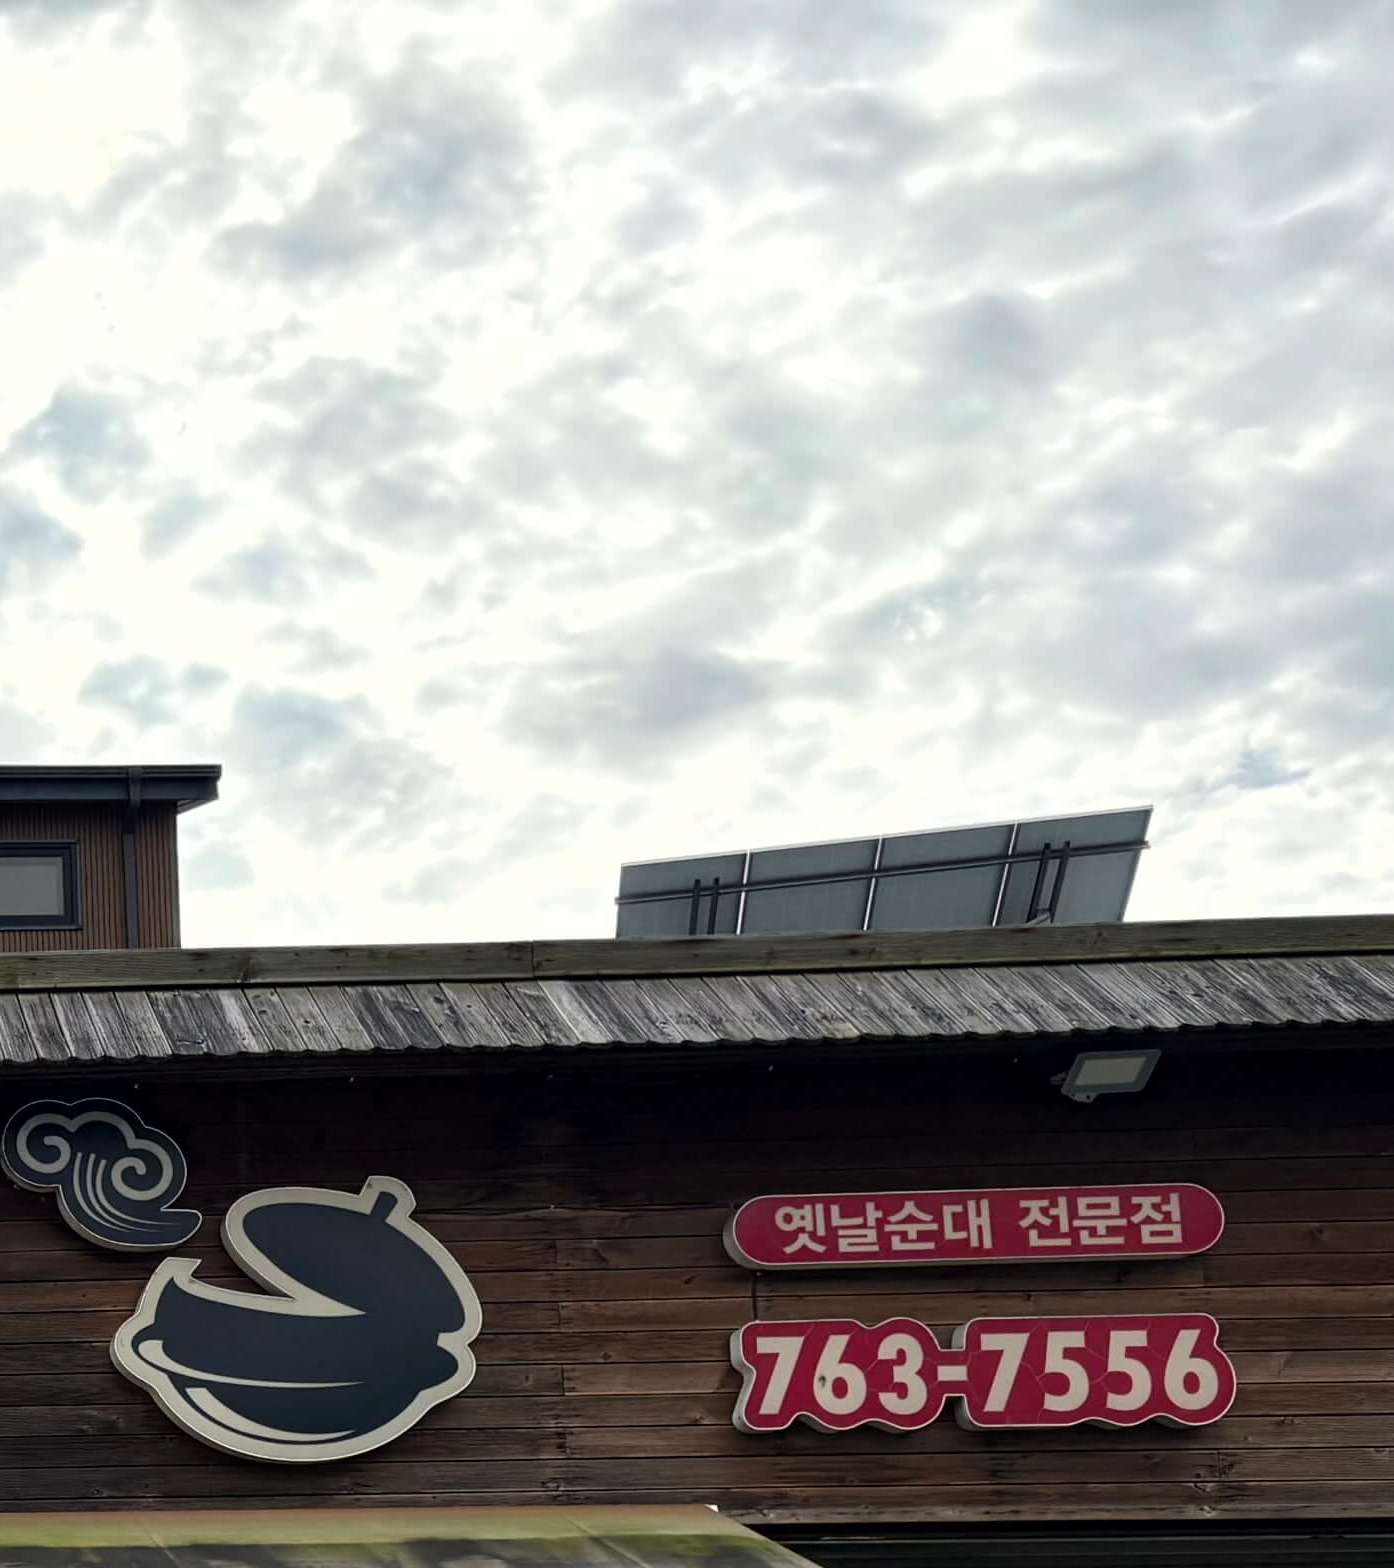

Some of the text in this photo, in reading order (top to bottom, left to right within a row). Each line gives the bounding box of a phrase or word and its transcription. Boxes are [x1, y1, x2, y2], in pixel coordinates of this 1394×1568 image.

[774, 1193, 1183, 1255] 옛날순대 전문점
[756, 1328, 1219, 1417] 763-7556
